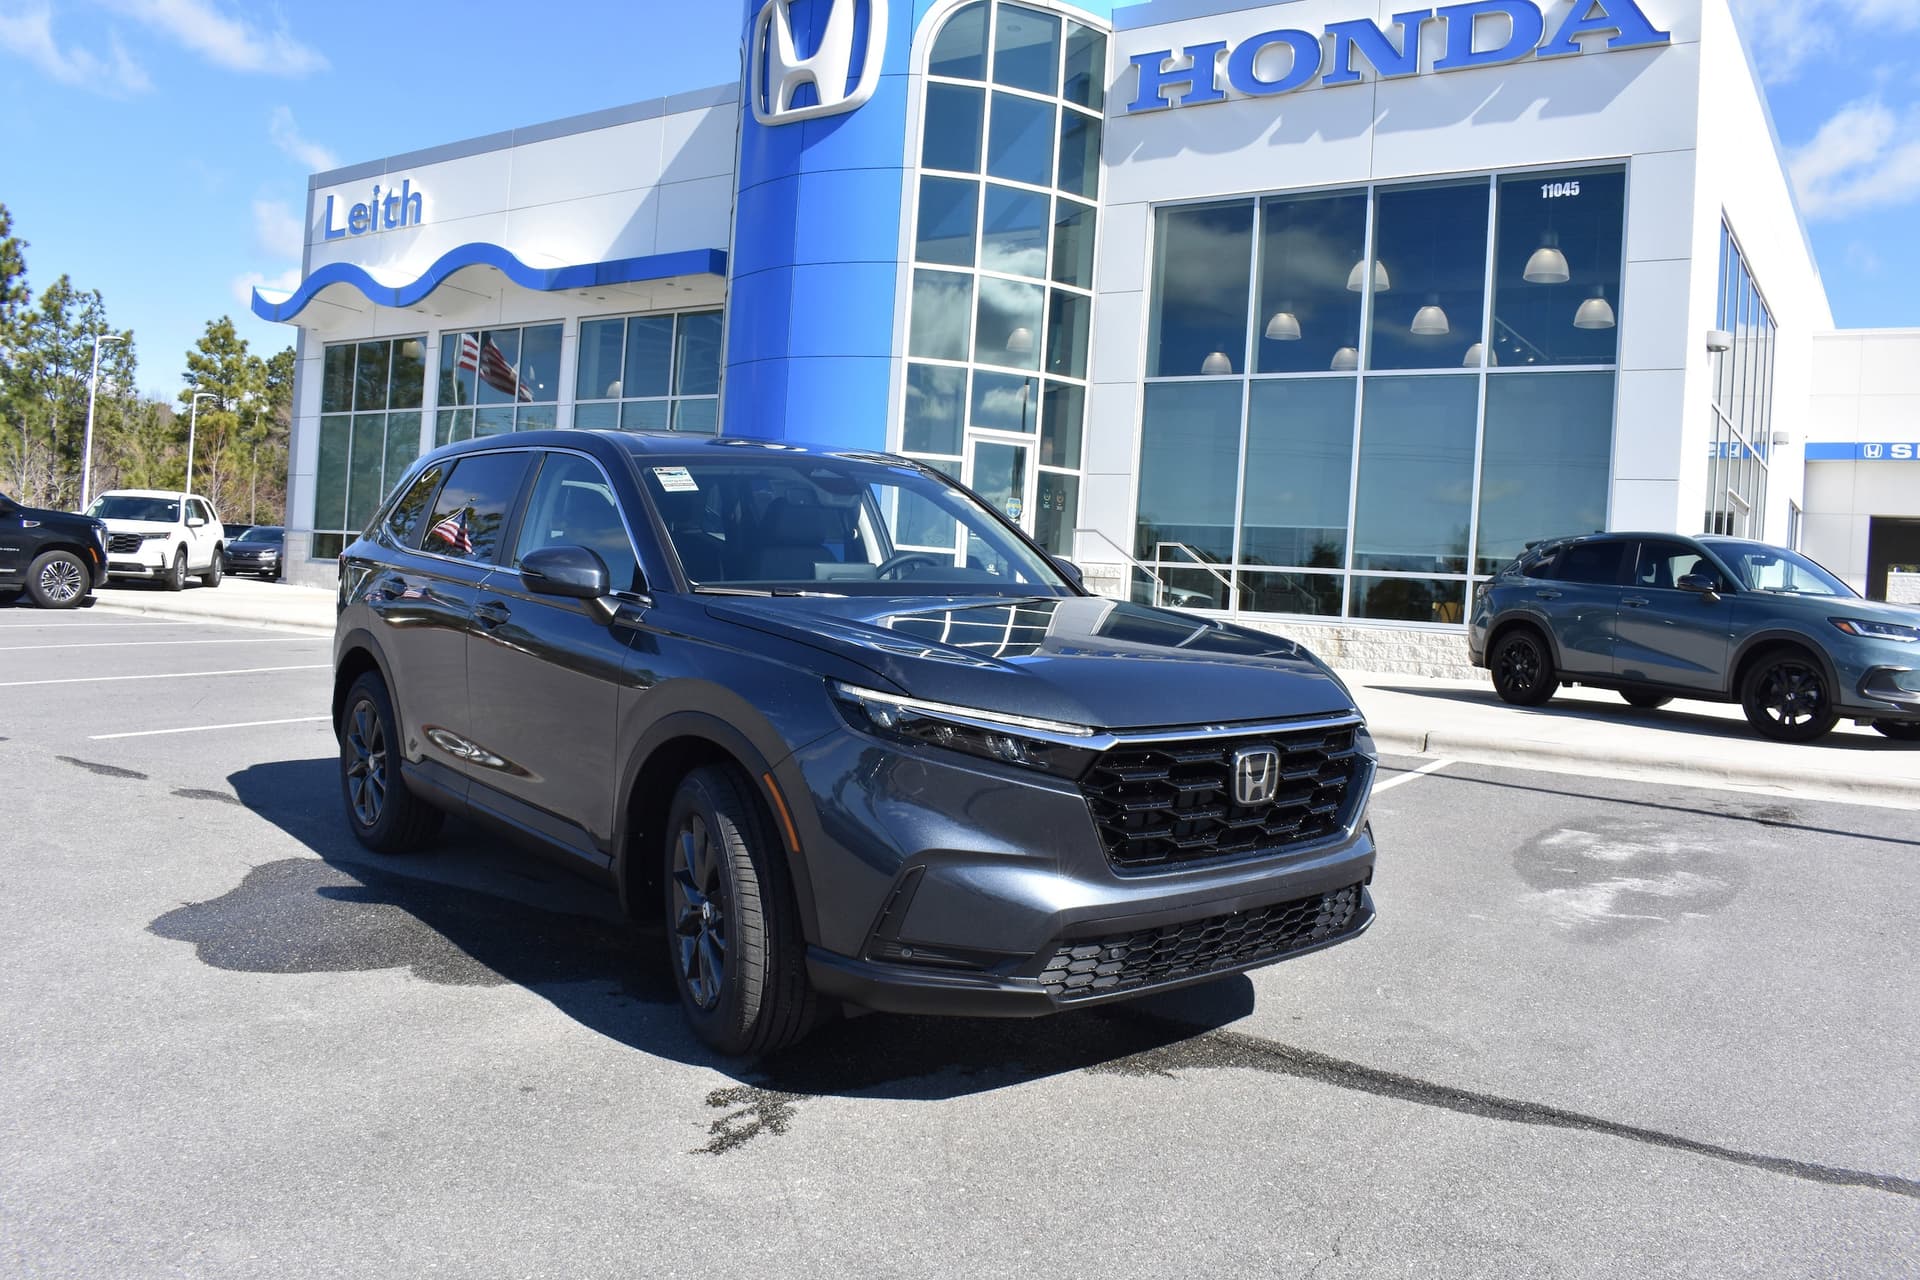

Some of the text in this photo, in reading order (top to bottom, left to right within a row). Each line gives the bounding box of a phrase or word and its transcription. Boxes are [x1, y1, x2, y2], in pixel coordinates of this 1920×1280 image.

[1126, 0, 1671, 113] HONDA
[1541, 181, 1580, 198] 11045
[325, 179, 423, 240] Leith
[1891, 443, 1920, 459] S
